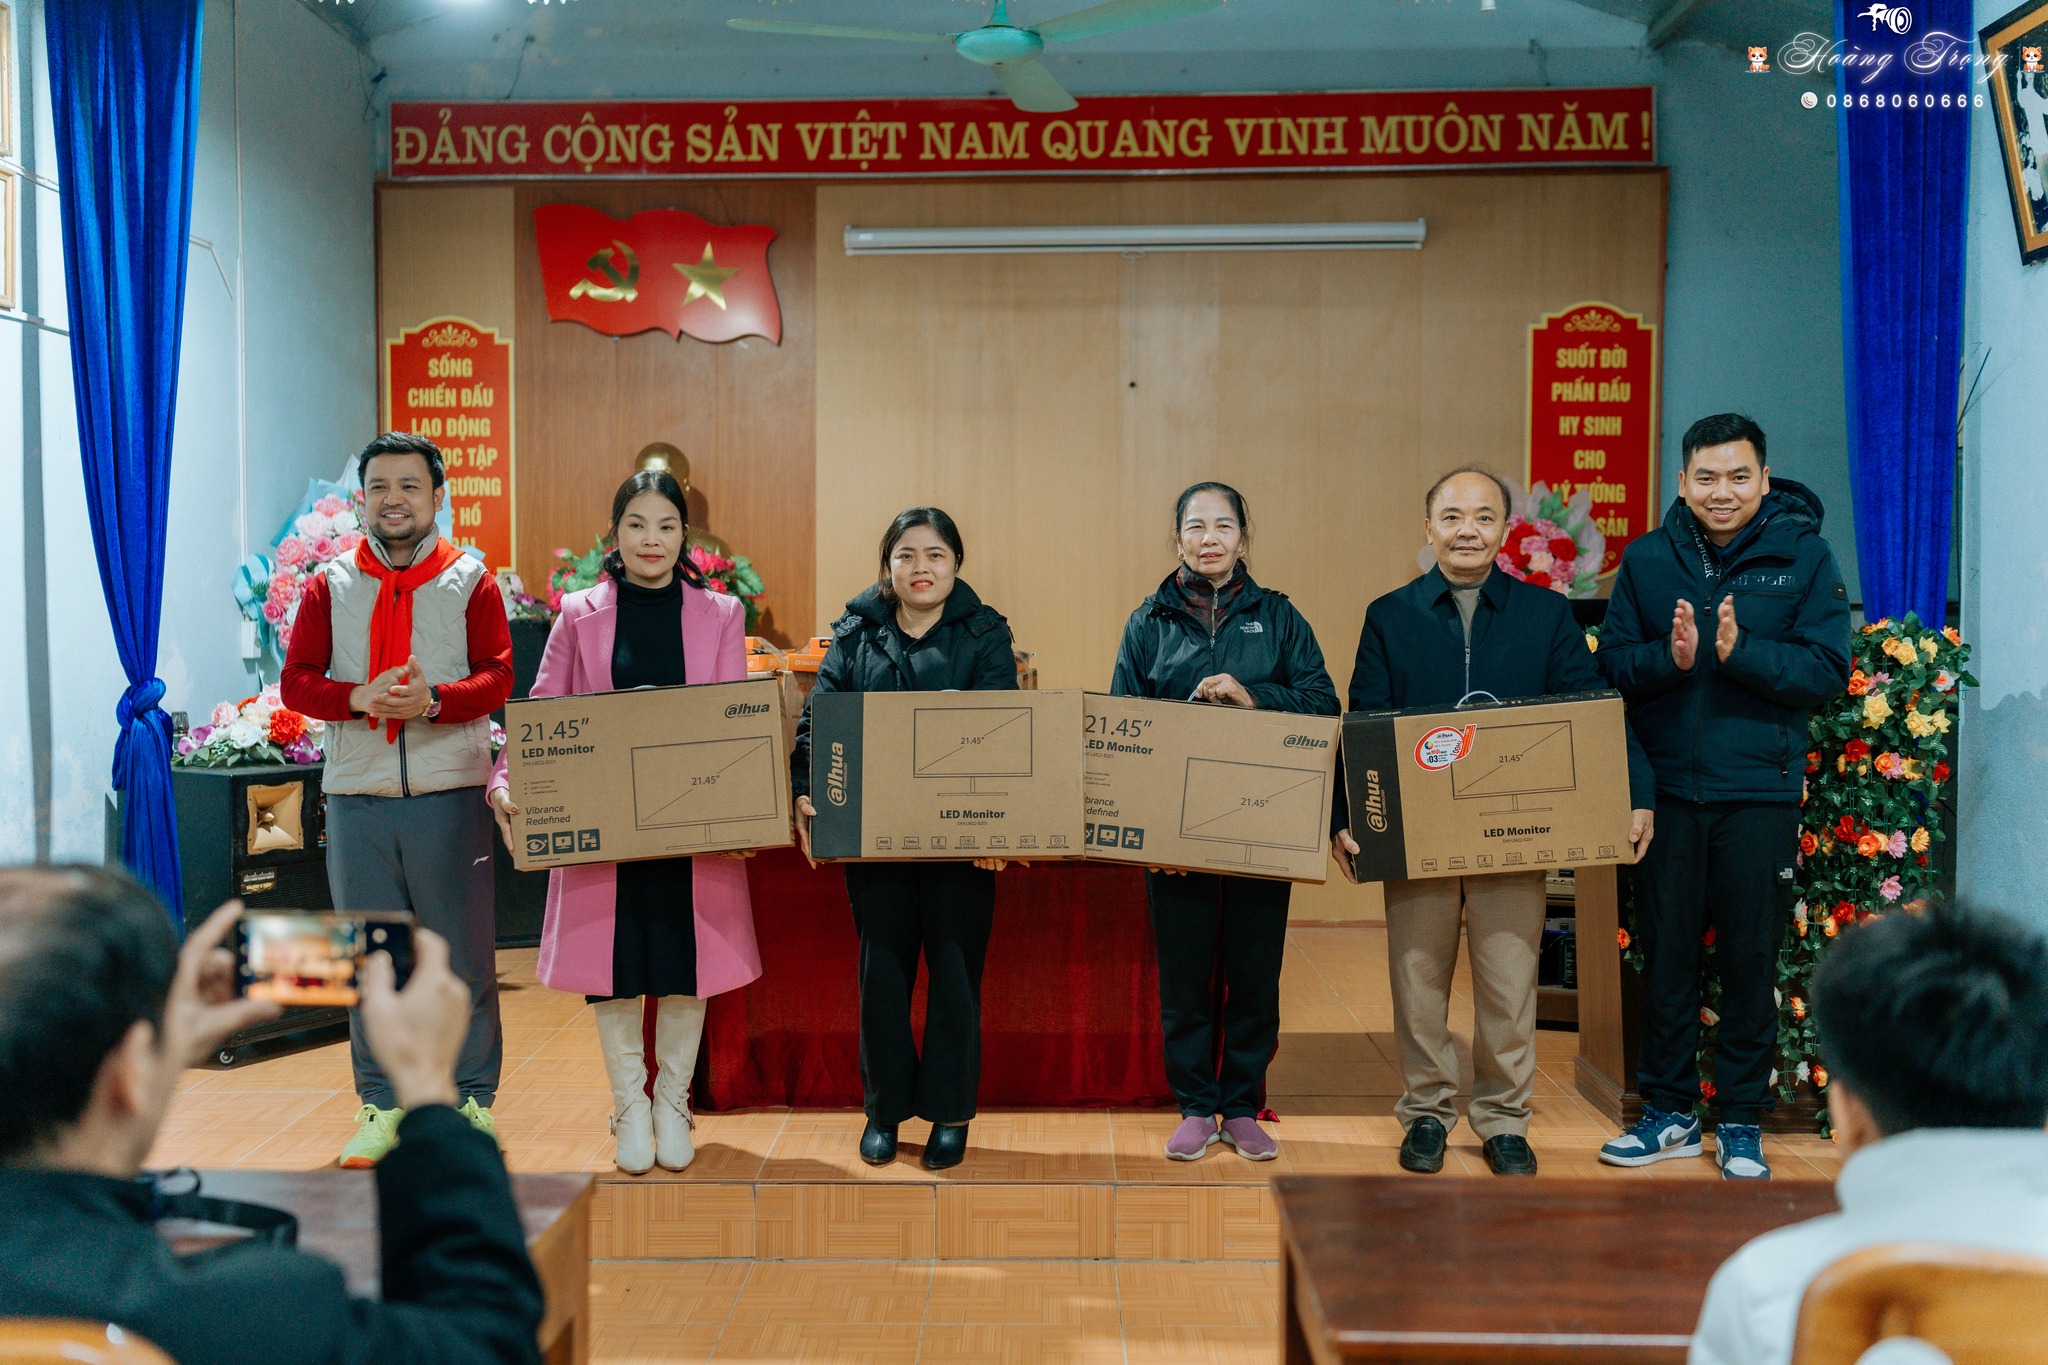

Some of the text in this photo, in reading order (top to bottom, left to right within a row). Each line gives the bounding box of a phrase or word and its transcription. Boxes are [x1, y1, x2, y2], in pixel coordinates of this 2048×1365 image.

[394, 102, 1651, 173] ĐẢNG CỘNG SẢN VIỆT NAM QUANG VINH MUÔN NĂM !
[1556, 341, 1627, 368] SUỐT ĐỜI
[428, 352, 473, 378] SỐNG
[407, 381, 494, 408] CHIẾN ĐẤU
[1551, 375, 1631, 402] PHẤN ĐẤU
[411, 414, 490, 441] LAO ĐỘNG
[1559, 416, 1622, 436] HY SINH
[441, 444, 498, 471] ỌC TẬP
[1573, 450, 1606, 470] CHO
[1596, 509, 1629, 537] SẢN
[522, 743, 595, 759] LED Monitor
[1085, 739, 1154, 755] ED Monitor
[1429, 755, 1439, 764] 03
[525, 805, 565, 815] Vibrance
[526, 814, 571, 826] Redefined
[939, 809, 1005, 819] LED Monitor
[1484, 826, 1551, 838] LED Monitor
